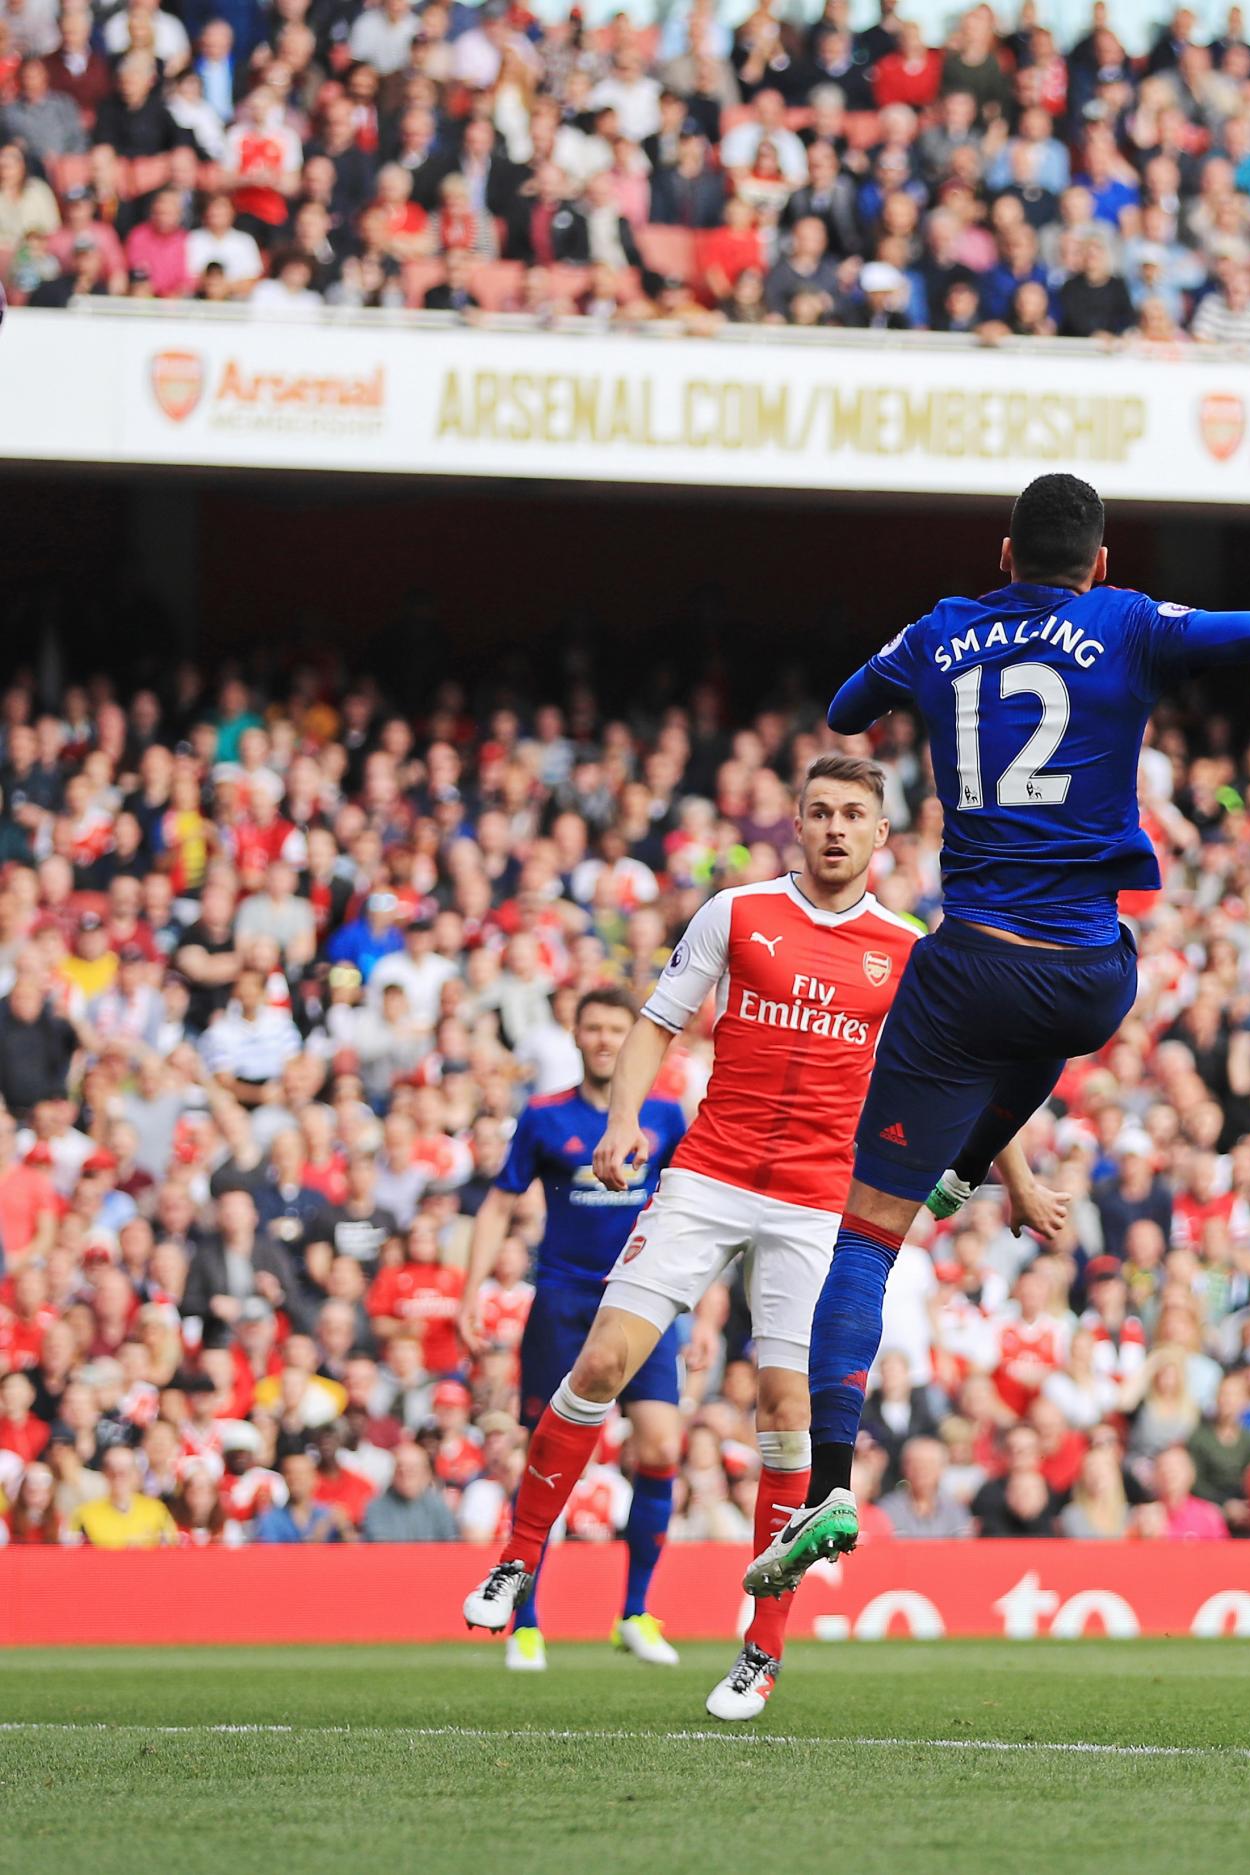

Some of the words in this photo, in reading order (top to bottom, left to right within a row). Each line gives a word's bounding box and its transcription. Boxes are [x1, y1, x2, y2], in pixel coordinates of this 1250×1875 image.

[216, 359, 386, 408] Arsenal
[436, 369, 1148, 462] ARSENAL.COM/MEMBERSHIP
[951, 661, 1072, 811] 12
[739, 989, 870, 1046] Emirates
[792, 973, 836, 1006] Fly
